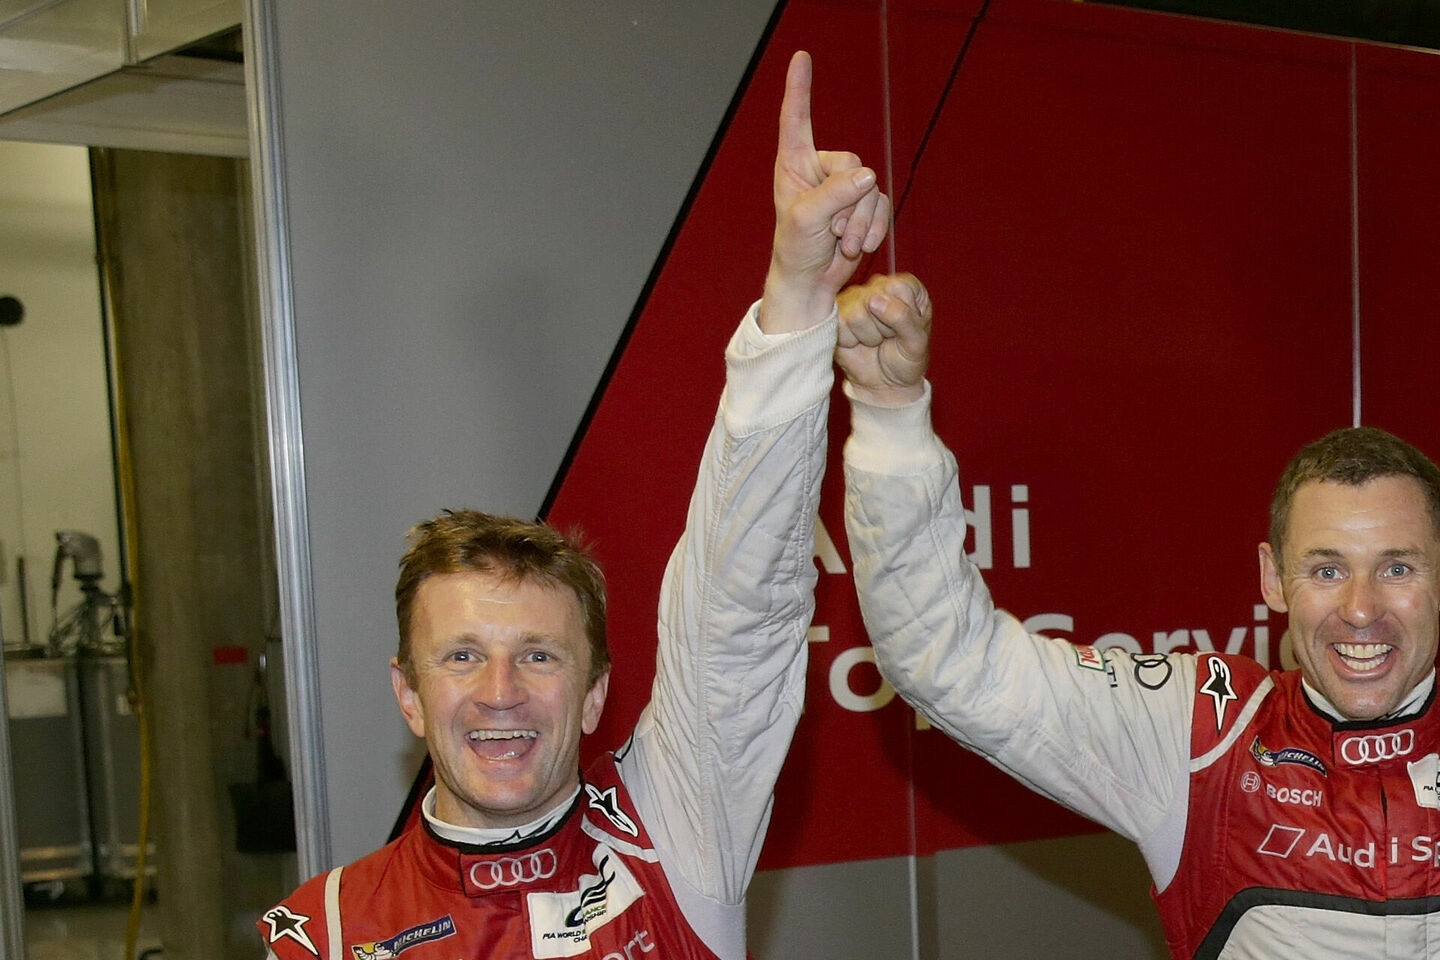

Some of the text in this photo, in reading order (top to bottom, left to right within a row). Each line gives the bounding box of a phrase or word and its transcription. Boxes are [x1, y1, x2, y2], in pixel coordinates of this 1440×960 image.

[1266, 783, 1323, 807] BOSCH
[1306, 833, 1399, 868] Audi
[393, 920, 451, 951] MICHELIN
